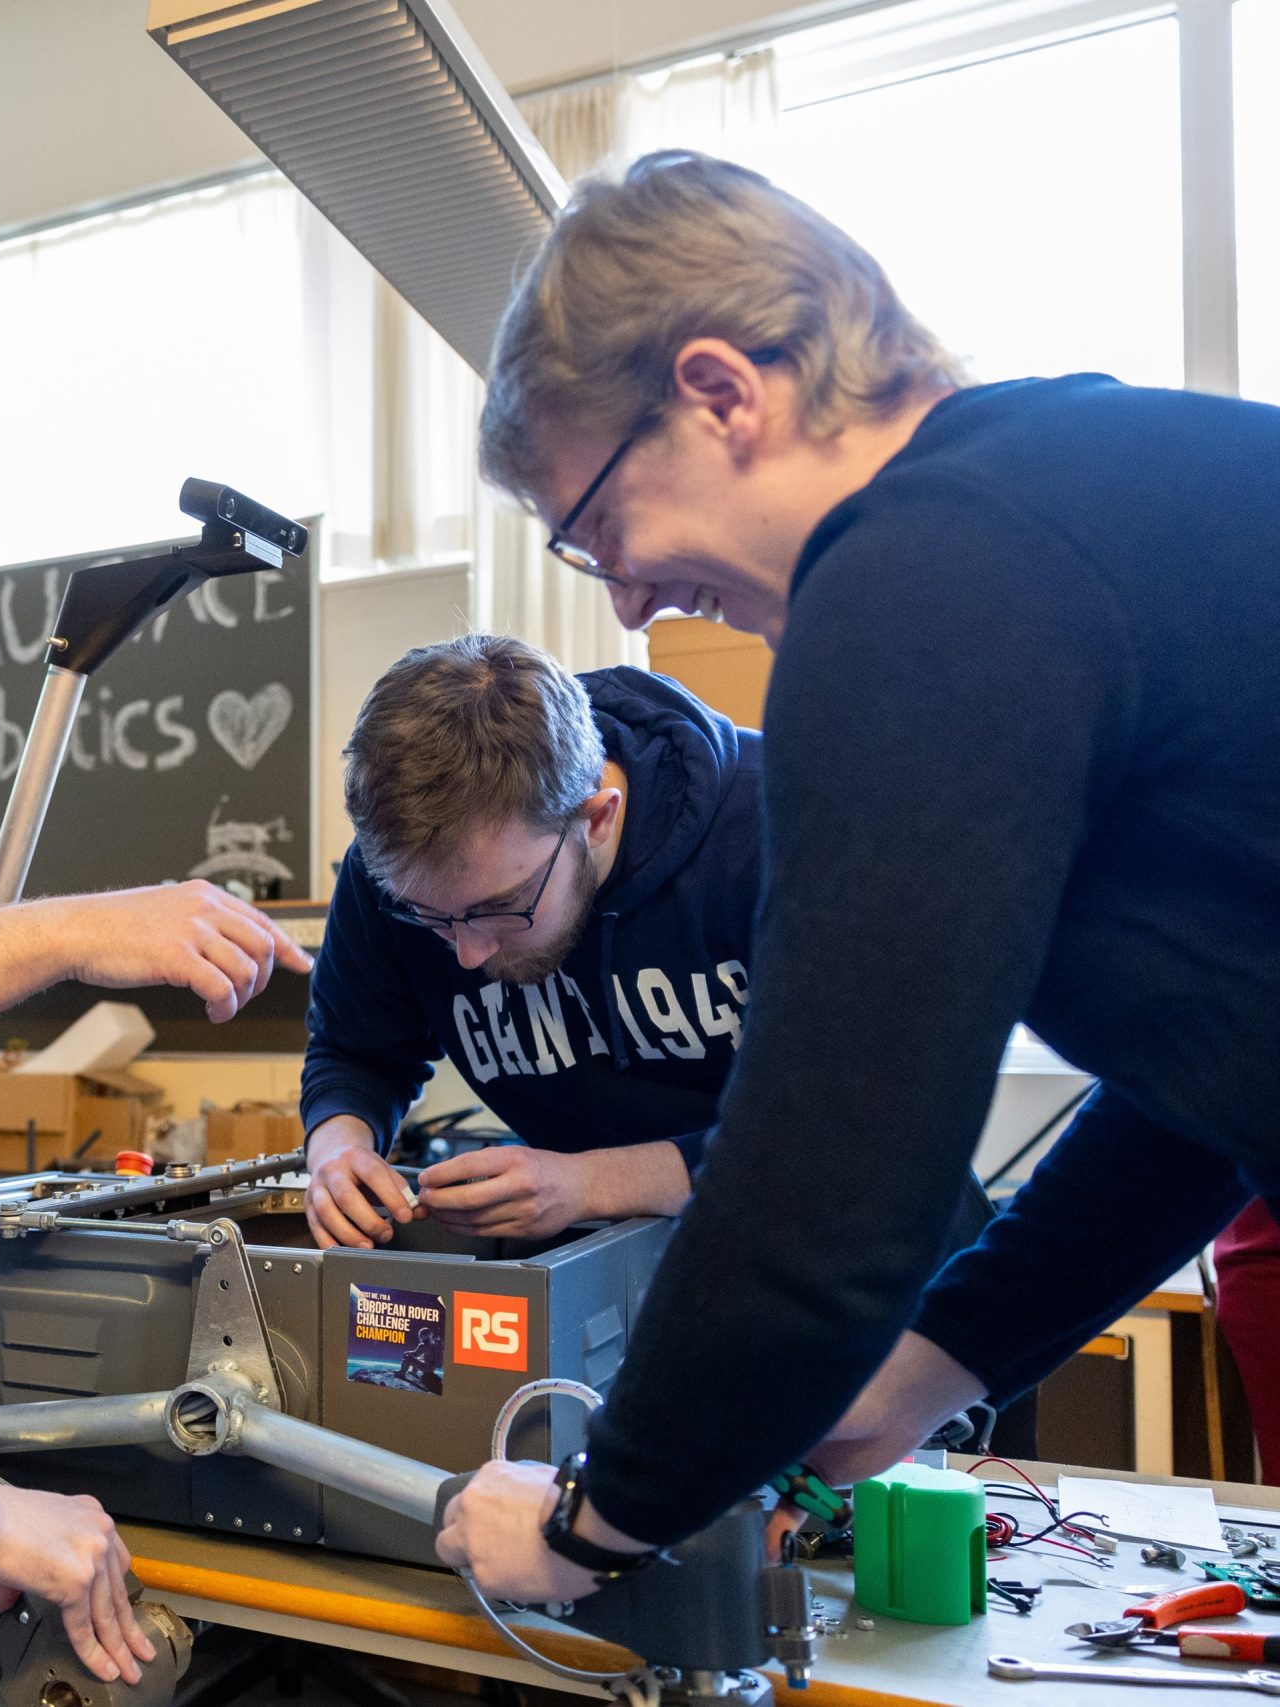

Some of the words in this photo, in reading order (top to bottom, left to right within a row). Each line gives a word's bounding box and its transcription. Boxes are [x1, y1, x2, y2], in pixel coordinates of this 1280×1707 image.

[357, 1298, 406, 1317] EUROPEAN
[408, 1305, 439, 1322] ROVER
[356, 1312, 411, 1331] CHALLENGE
[461, 1308, 519, 1355] RS
[356, 1325, 405, 1344] CHAMPION
